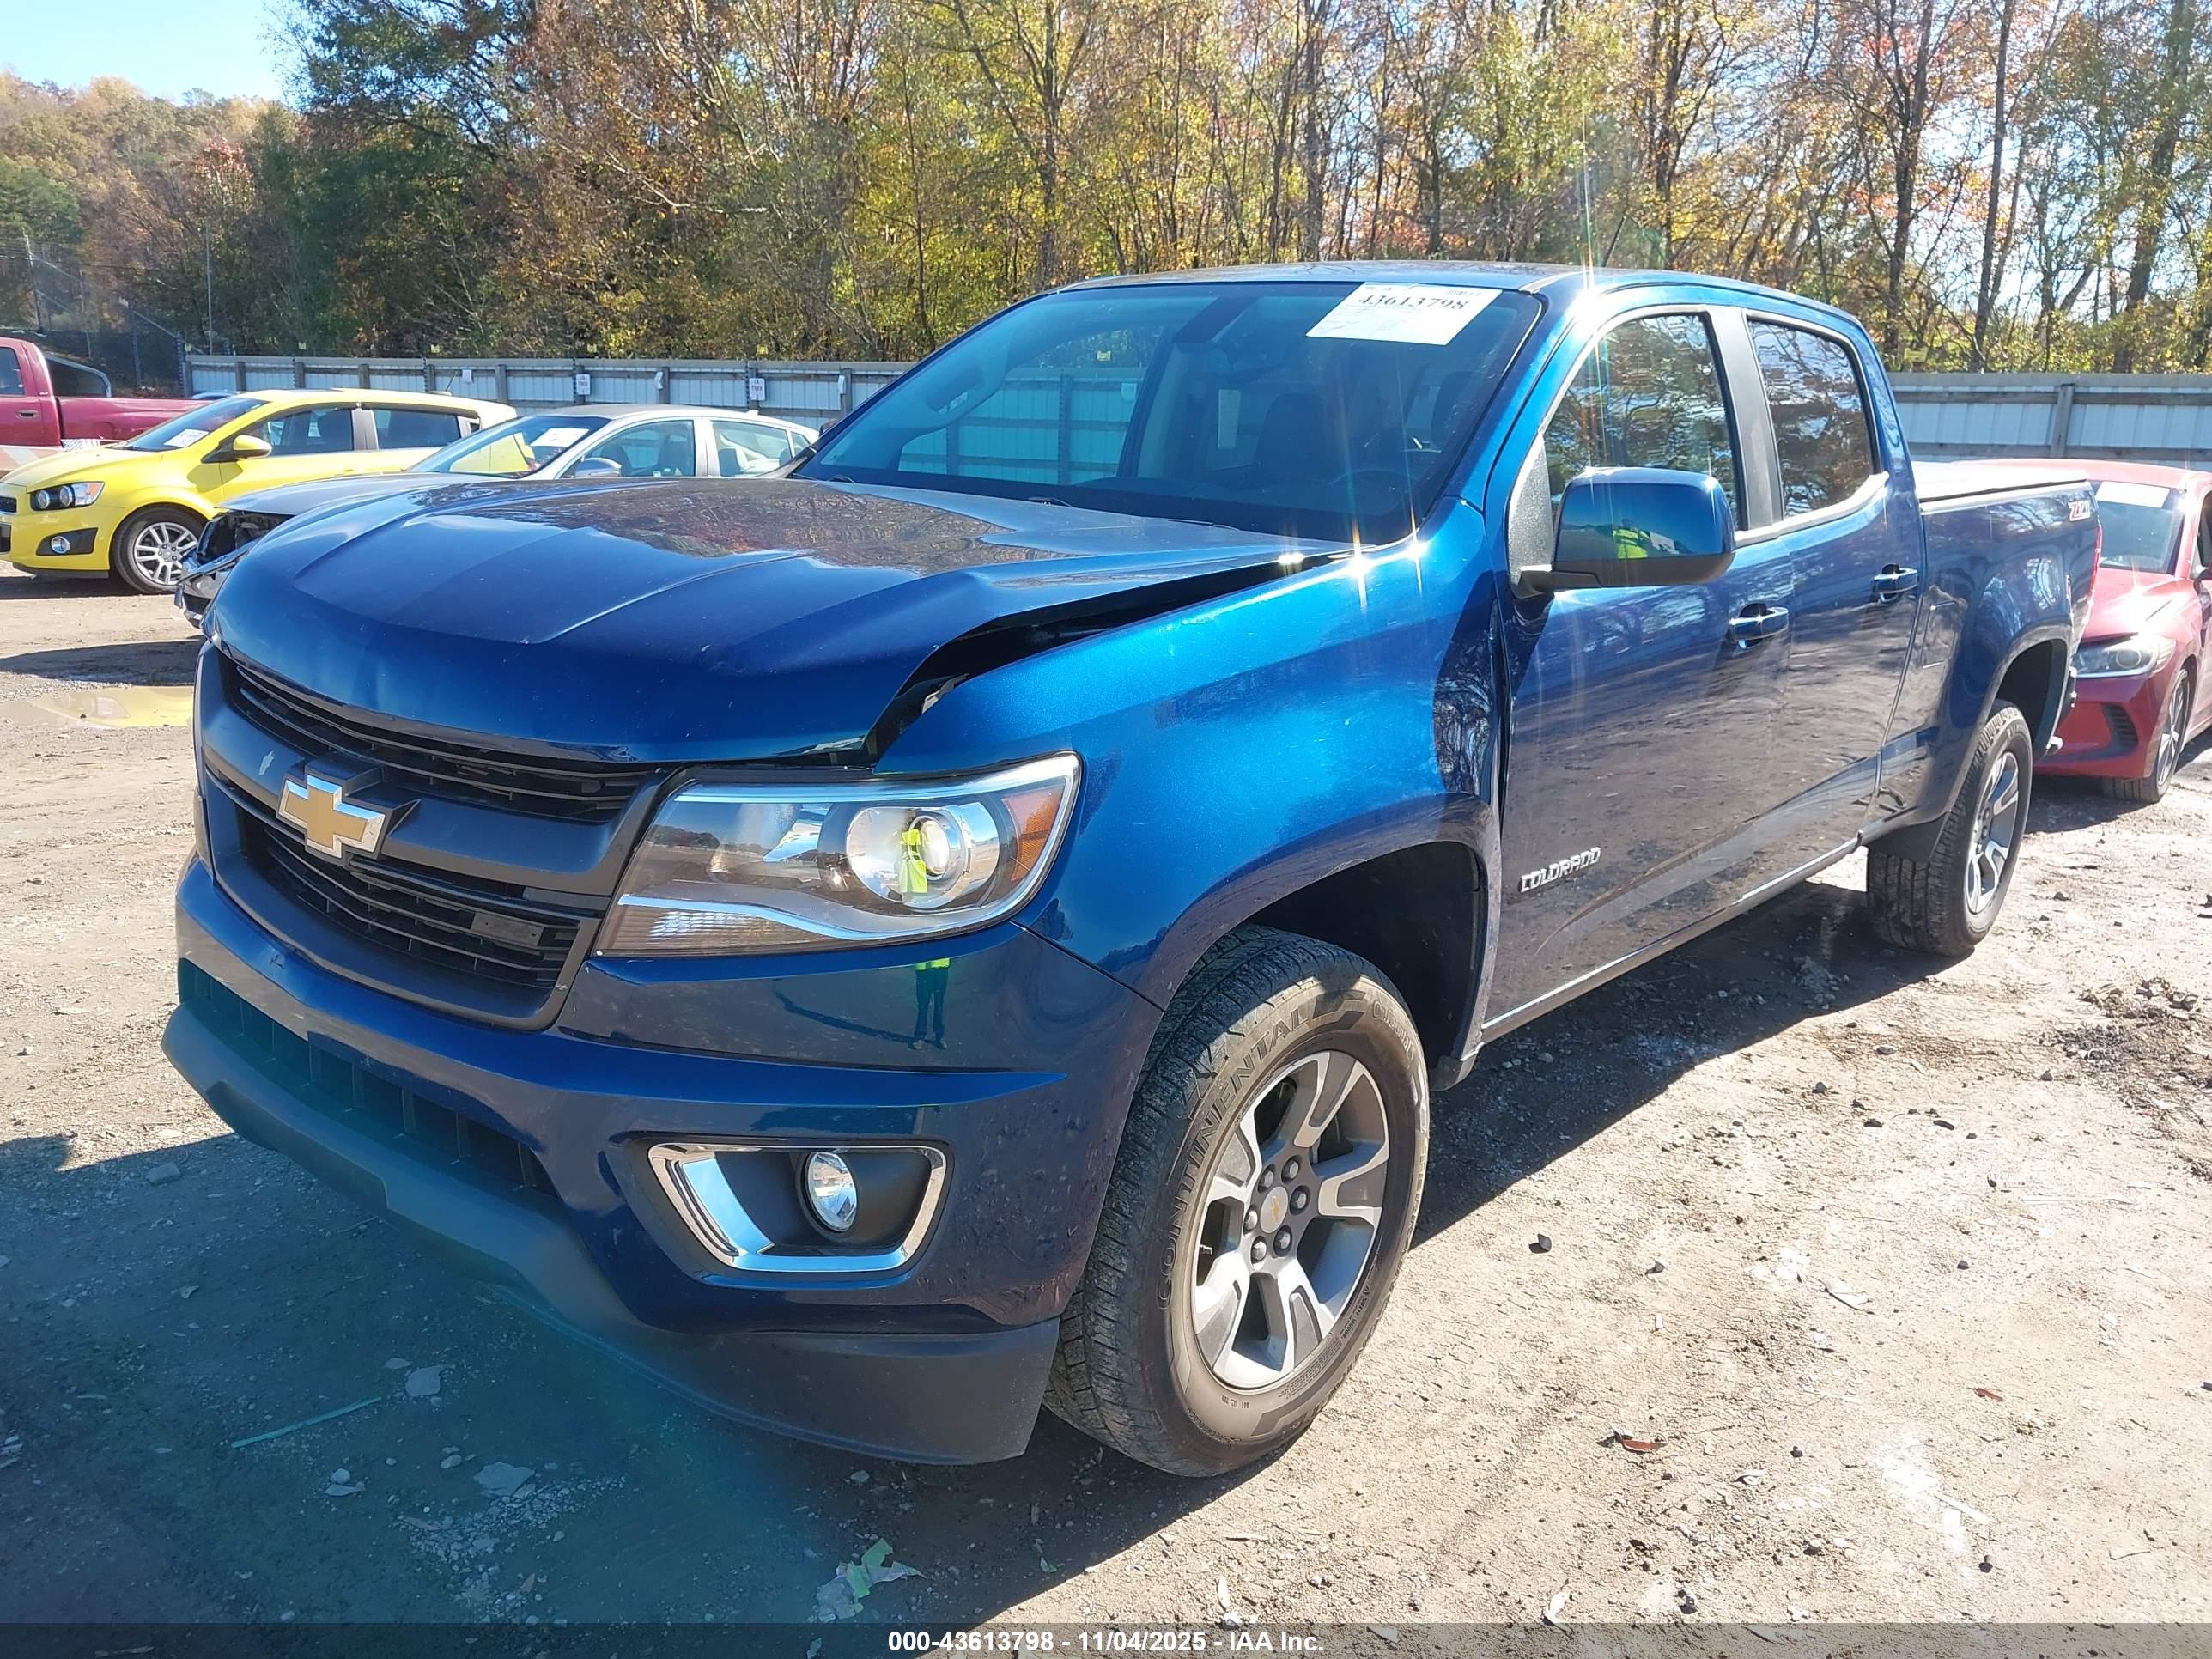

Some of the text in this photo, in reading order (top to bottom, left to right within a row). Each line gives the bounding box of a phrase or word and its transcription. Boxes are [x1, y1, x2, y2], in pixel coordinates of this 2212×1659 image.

[1358, 295, 1469, 310] 43613798
[1520, 846, 1601, 893] COLORADO
[1159, 1007, 1310, 1310] CONTINENTAL
